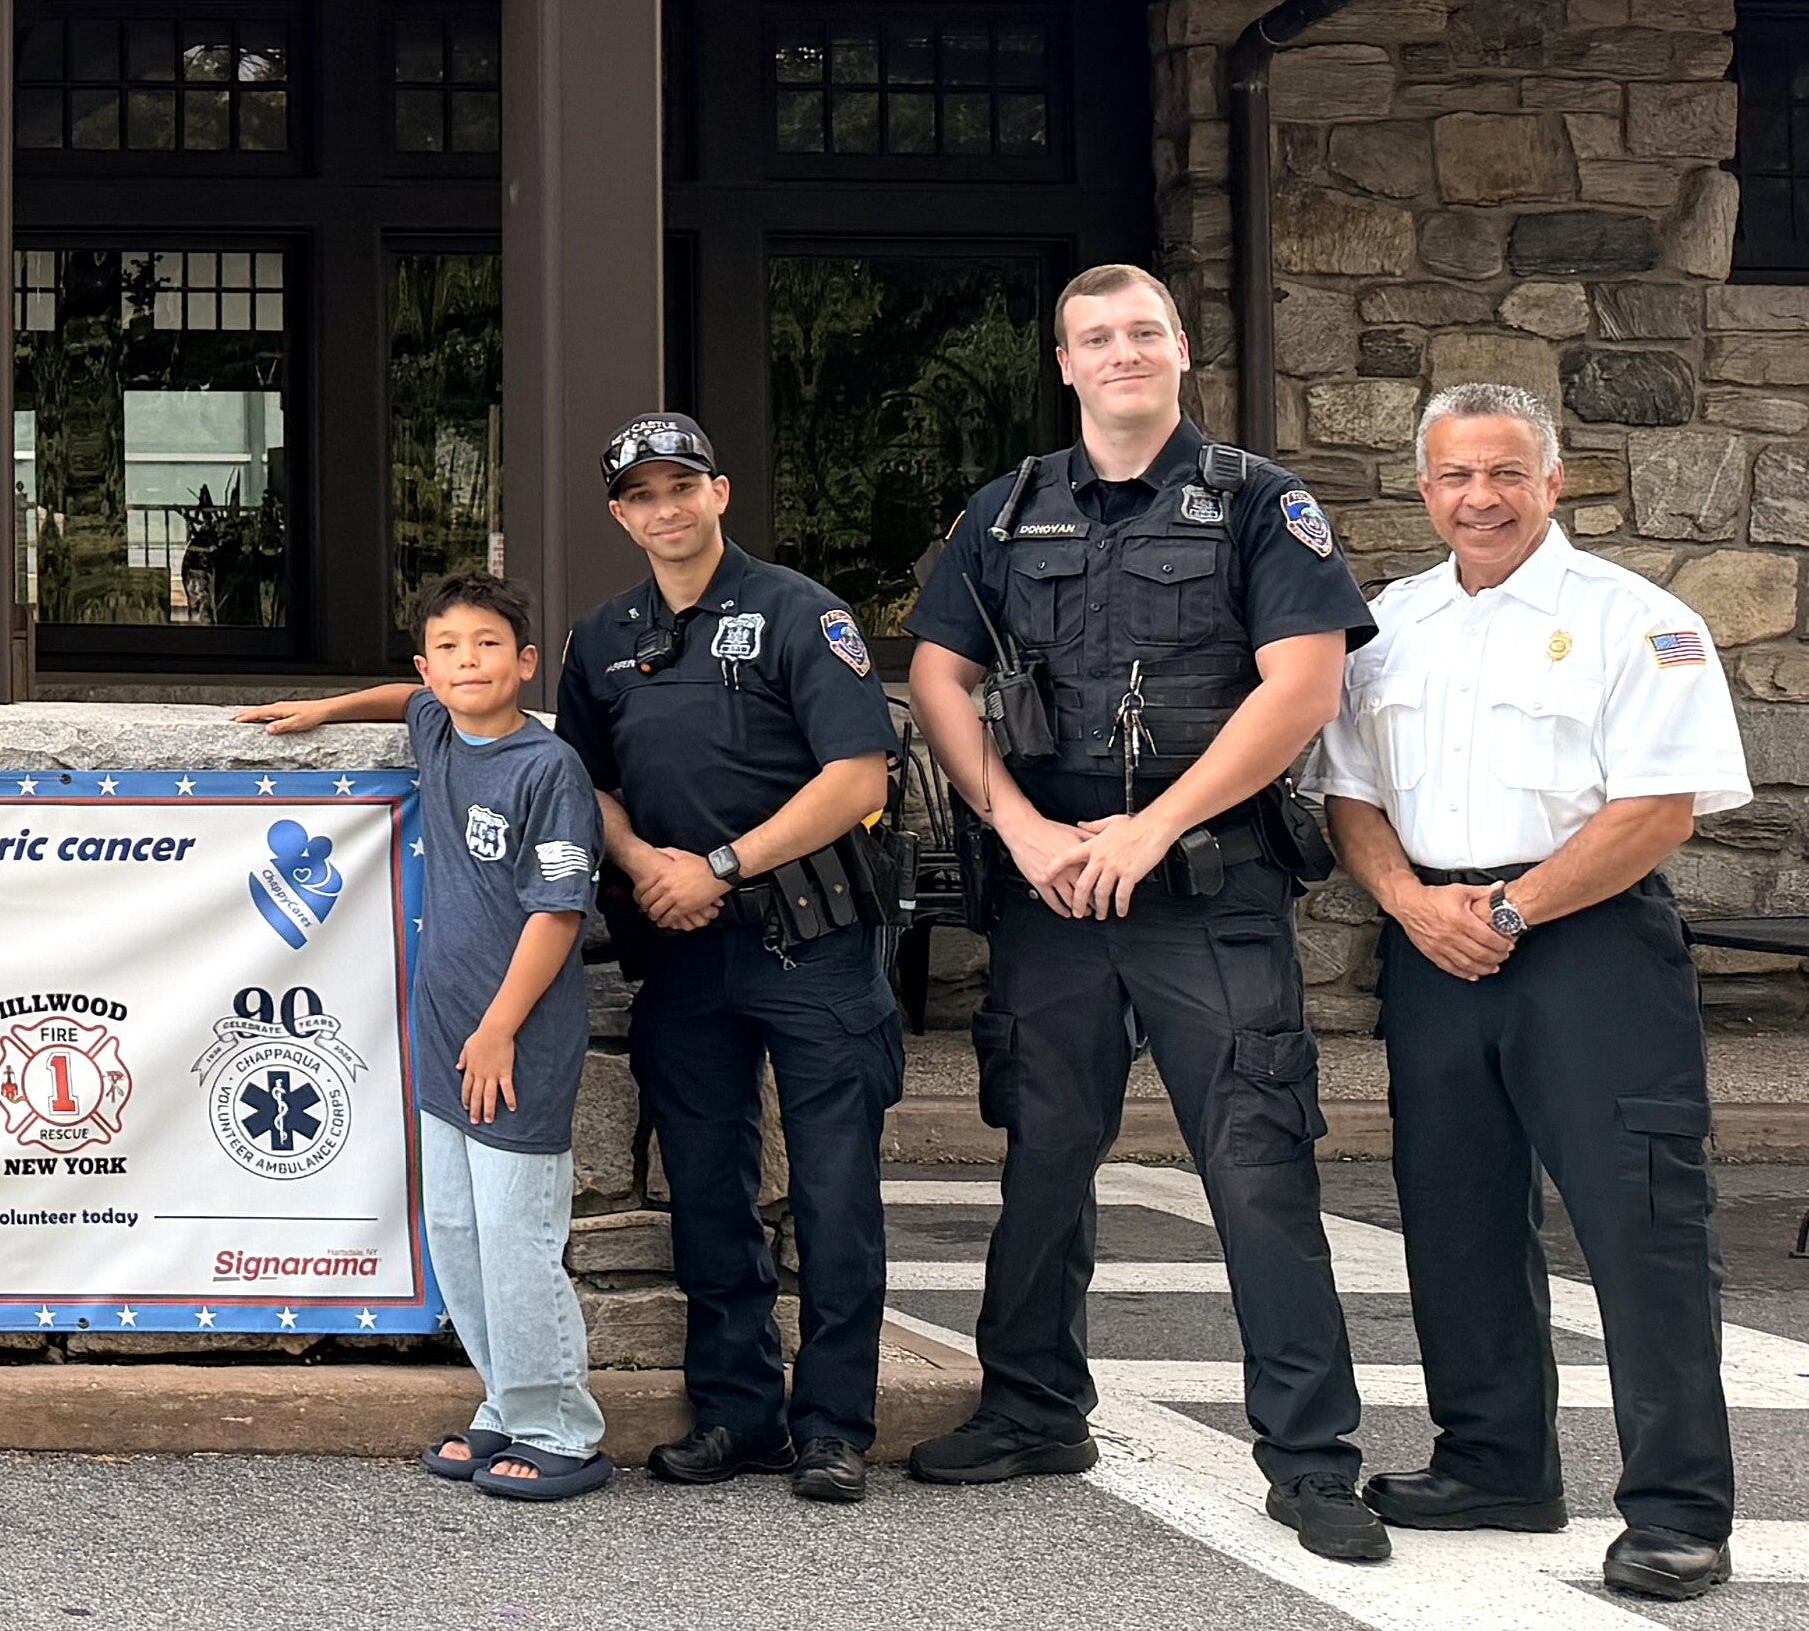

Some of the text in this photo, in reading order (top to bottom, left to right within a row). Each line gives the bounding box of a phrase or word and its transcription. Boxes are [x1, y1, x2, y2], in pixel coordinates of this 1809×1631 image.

[1020, 524, 1075, 534] DONOVAN
[57, 834, 195, 863] cancer
[262, 869, 312, 928] ChappyCares
[233, 986, 323, 1039] 90
[40, 1027, 78, 1042] FIRE
[223, 1020, 282, 1034] CELEBRATE
[236, 1049, 321, 1073] CHAPPAQUA
[46, 1052, 80, 1115] 1
[40, 1128, 89, 1140] RESCUE
[218, 1086, 345, 1174] VOLUNTEER AMBULANCE CORPS
[3, 1157, 127, 1175] NEW YORK
[83, 1208, 138, 1227] today
[215, 1250, 377, 1281] Signarama
